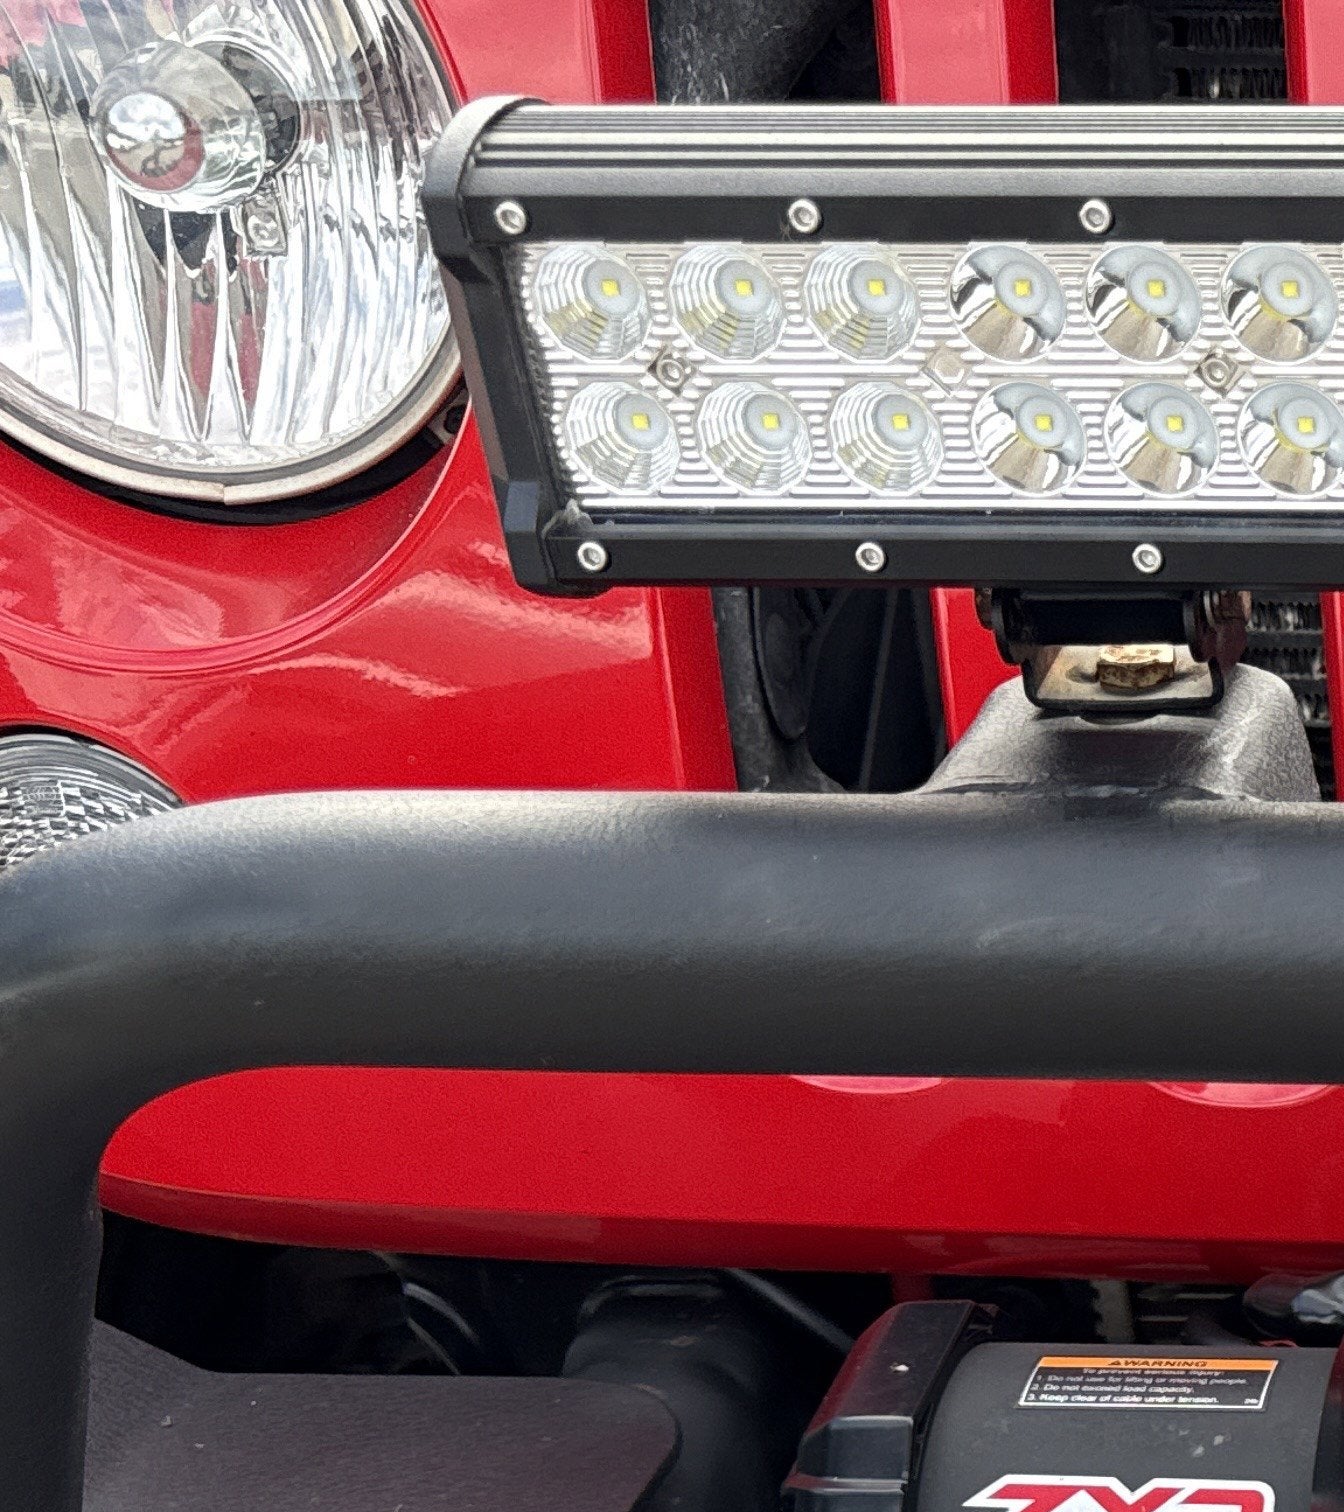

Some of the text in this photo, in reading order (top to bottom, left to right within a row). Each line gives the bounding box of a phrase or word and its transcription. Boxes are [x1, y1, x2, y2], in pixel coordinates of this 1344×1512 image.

[1124, 1360, 1208, 1368] WARNING
[1039, 1393, 1068, 1402] Keep
[1070, 1394, 1097, 1402] clear
[1099, 1394, 1111, 1402] of
[1143, 1395, 1176, 1403] under
